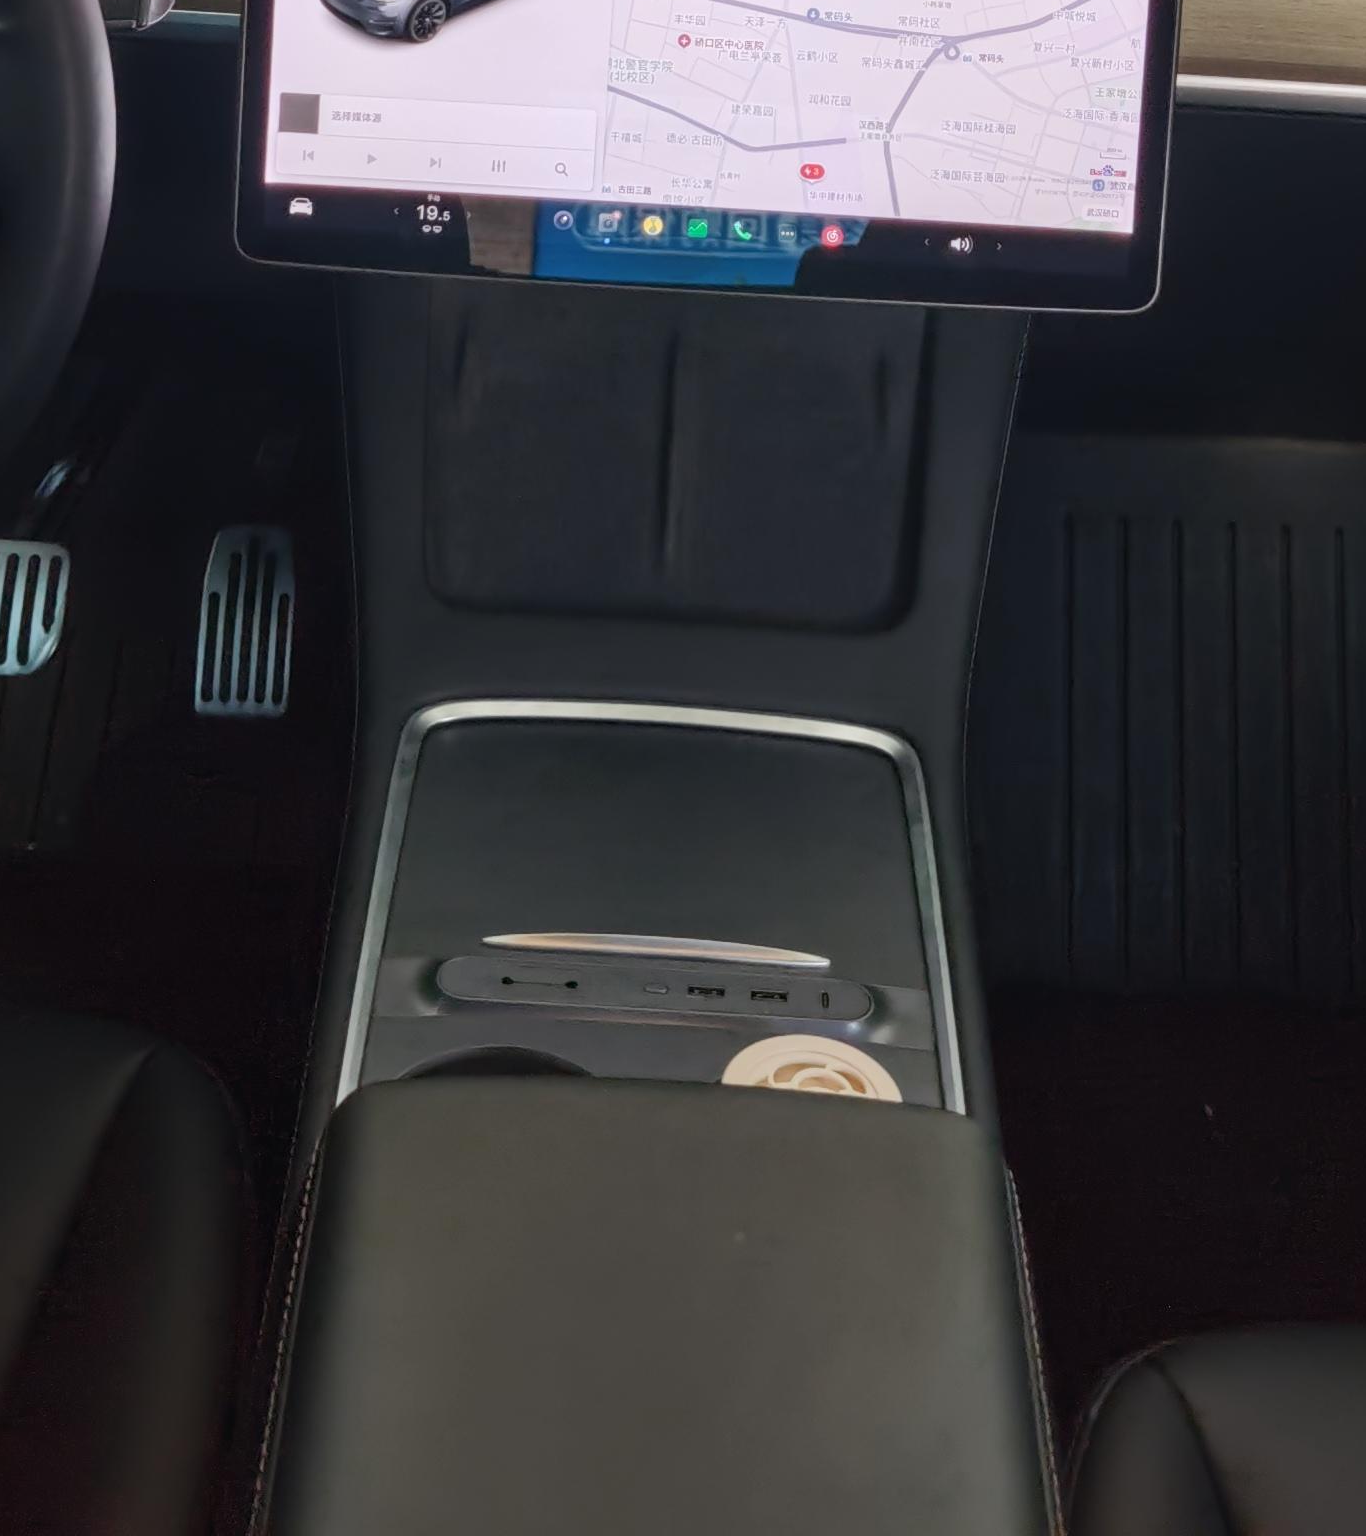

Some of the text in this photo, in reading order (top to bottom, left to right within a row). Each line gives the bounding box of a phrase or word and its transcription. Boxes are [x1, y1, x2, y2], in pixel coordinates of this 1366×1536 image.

[1094, 87, 1142, 99] 王家墩公
[331, 110, 382, 123] 选择媒体源
[417, 205, 450, 221] 19.5
